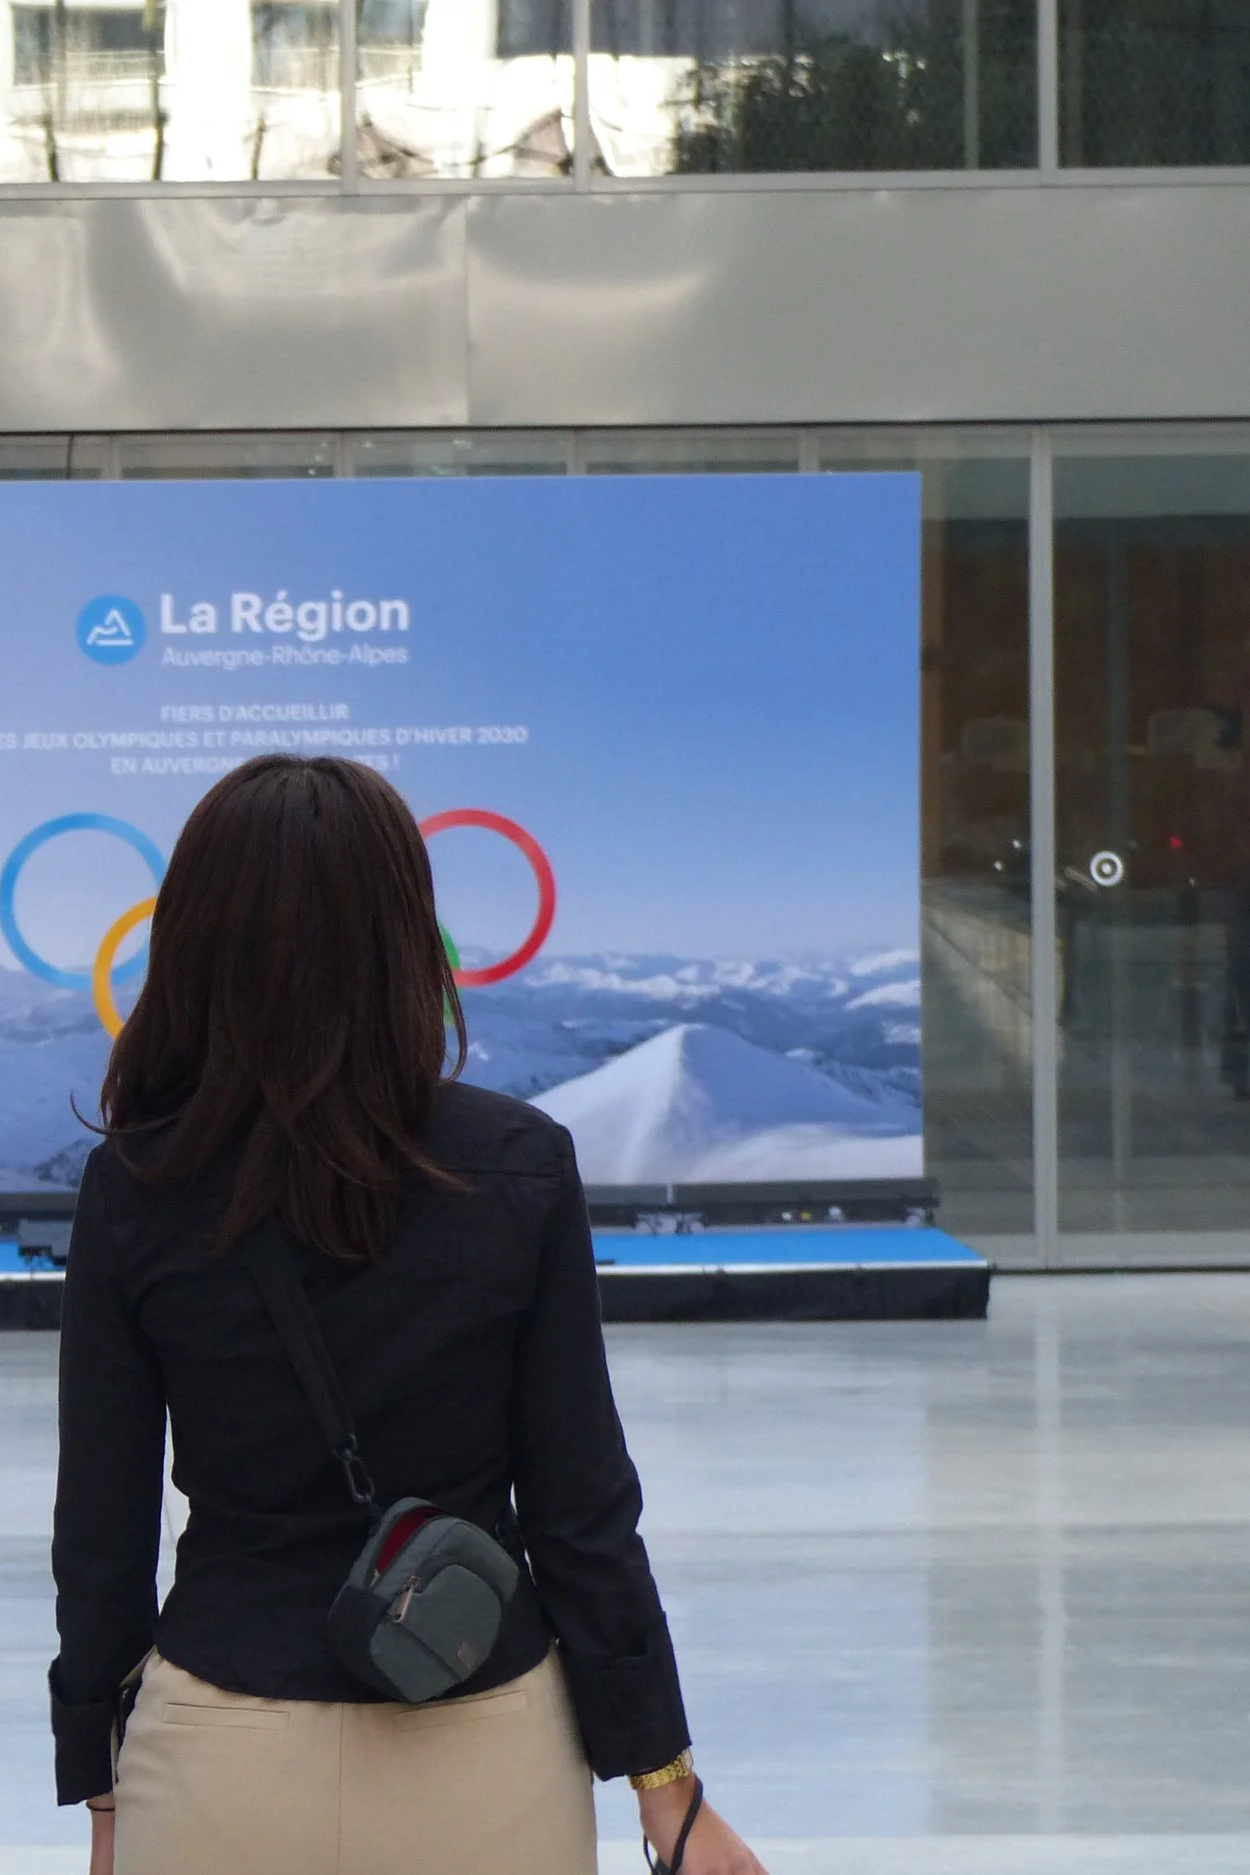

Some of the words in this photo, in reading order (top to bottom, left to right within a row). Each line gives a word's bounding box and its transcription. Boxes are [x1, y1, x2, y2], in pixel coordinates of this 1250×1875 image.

[159, 592, 217, 633] La
[231, 590, 409, 641] Région
[161, 643, 409, 670] Auvergne-Rhône-Alpes
[161, 704, 214, 722] FIERS
[218, 703, 349, 722] D'ACCUEILLIR
[23, 731, 69, 750] JEUX
[73, 730, 199, 749] OLYMPIQUES
[203, 730, 226, 748] ET
[230, 728, 391, 748] PARALYMPIQUES
[396, 727, 473, 746] D'HIVER
[477, 726, 528, 745] 2030
[111, 757, 137, 774] EN
